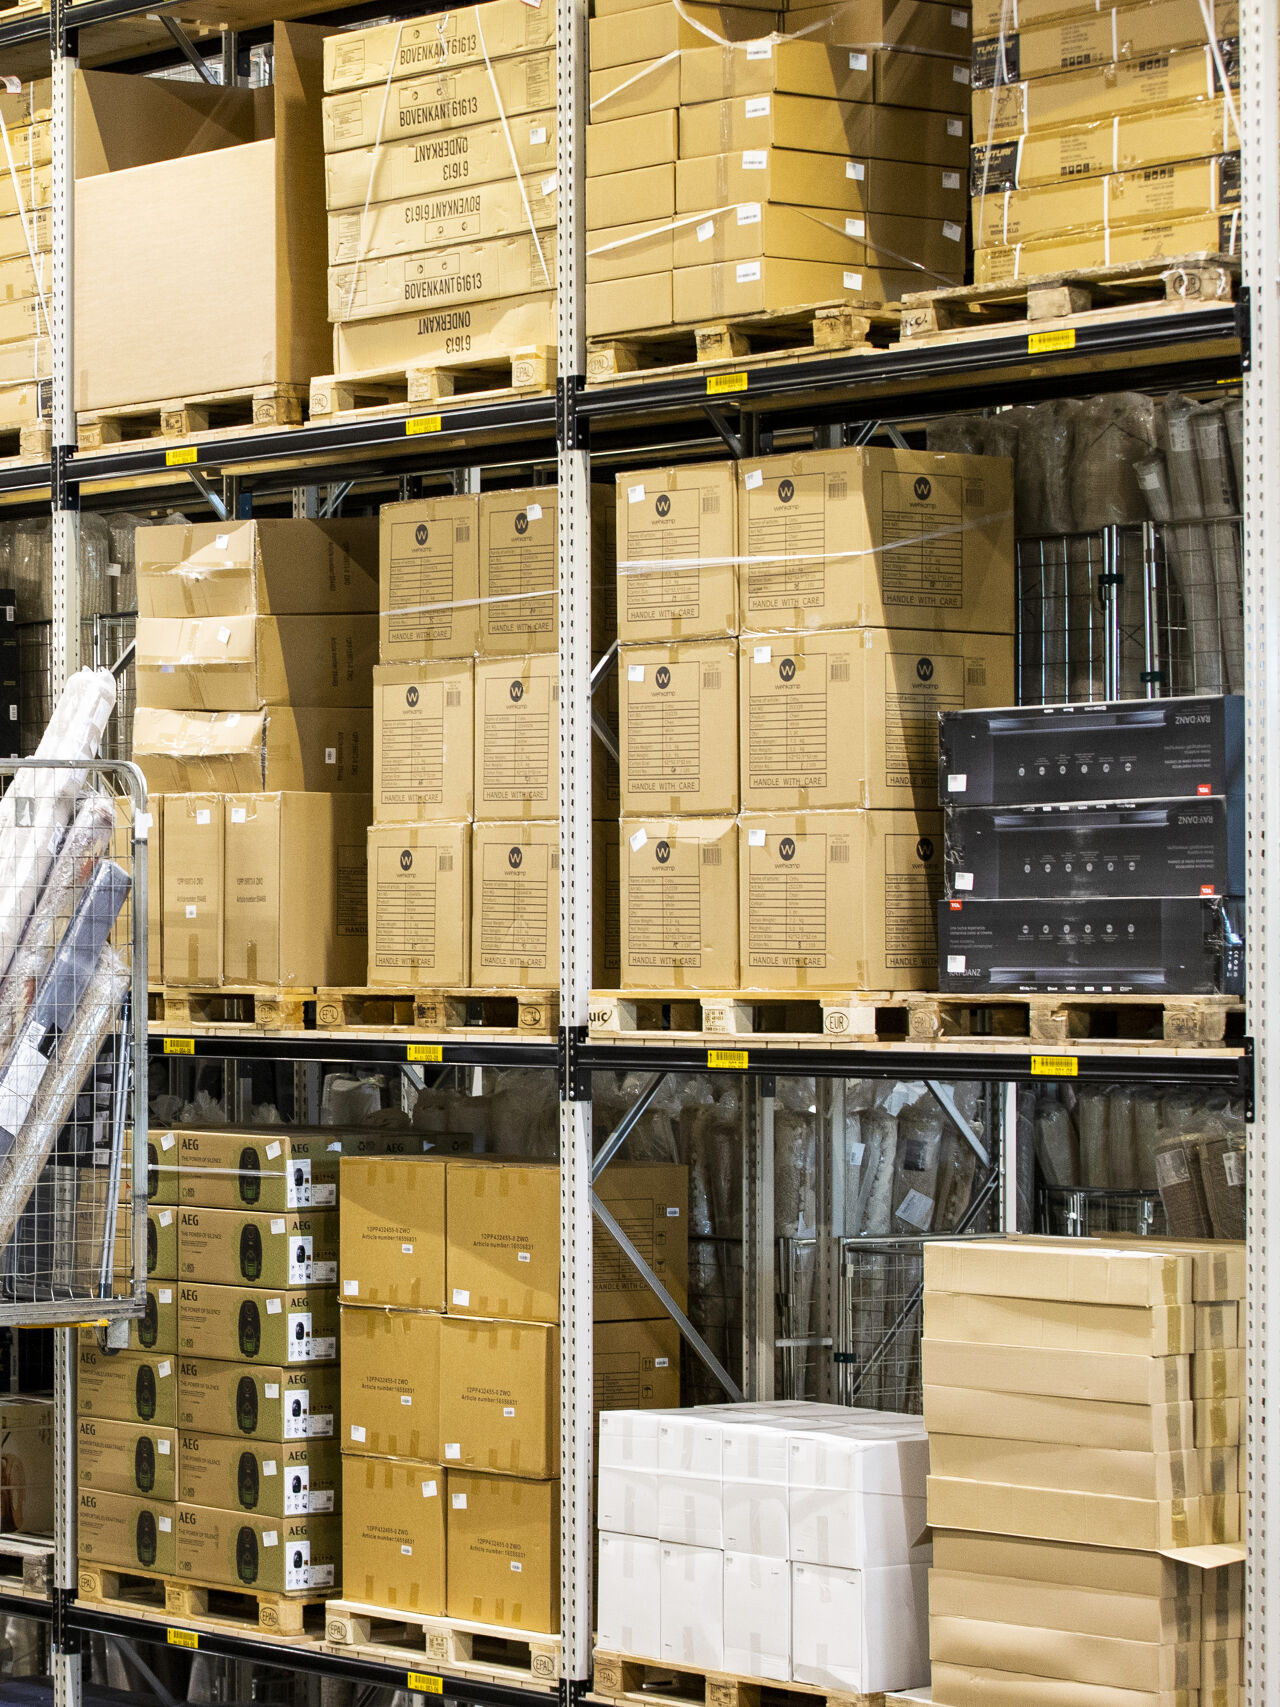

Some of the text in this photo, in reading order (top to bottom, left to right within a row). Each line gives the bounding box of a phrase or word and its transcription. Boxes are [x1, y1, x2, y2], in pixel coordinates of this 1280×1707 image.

[400, 34, 477, 65] BOVENKANT 61613
[977, 41, 1015, 54] TUNTRI
[399, 97, 478, 127] BOVENKANT 61613
[414, 137, 469, 181] ONDERKANT 61613
[405, 195, 481, 224] BOVENKANT 61613
[404, 272, 482, 300] BOVENKANT 61613
[418, 310, 471, 354] ONDERKANT 61613
[752, 597, 820, 608] HANDLE WITH CARE
[886, 594, 958, 606] HANDLE WITH CARE
[630, 608, 695, 619] HANDLE WITH CARE
[492, 622, 550, 632] HANDLE WITH CARE
[392, 630, 448, 640] HANDLE WITH CARE
[631, 782, 696, 791] HANDLE WITH CARE
[753, 777, 822, 786] HANDLE WITH CARE
[890, 776, 918, 785] HANDLE
[378, 957, 400, 965] HANDLE
[417, 958, 431, 966] CARE
[484, 957, 507, 965] HANDLE
[527, 958, 542, 966] CARE
[632, 956, 697, 965] HANDLE WITH CARE
[752, 956, 822, 965] HANDLE WITH CARE
[890, 957, 918, 966] HANDLE
[830, 1016, 844, 1030] EUR
[182, 1139, 199, 1151] AEG
[292, 1143, 309, 1154] AEG
[386, 1144, 404, 1153] AEG
[181, 1214, 199, 1226] AEG
[292, 1220, 310, 1231] AEG
[473, 1240, 490, 1248] Article
[180, 1290, 198, 1302] AEG
[291, 1297, 309, 1308] AEG
[80, 1352, 96, 1365] AEG
[180, 1363, 198, 1376] AEG
[288, 1375, 307, 1385] AEG
[80, 1424, 96, 1436] AEG
[182, 1438, 199, 1450] AEG
[289, 1451, 308, 1460] AEG
[80, 1496, 97, 1508] AEG
[178, 1512, 196, 1525] AEG
[289, 1526, 308, 1536] AEG
[362, 1532, 376, 1540] Article
[80, 1577, 96, 1590] EPAL
[262, 1610, 278, 1623] EPAL
[330, 1624, 345, 1636] EPAL
[535, 1658, 552, 1672] EPAL
